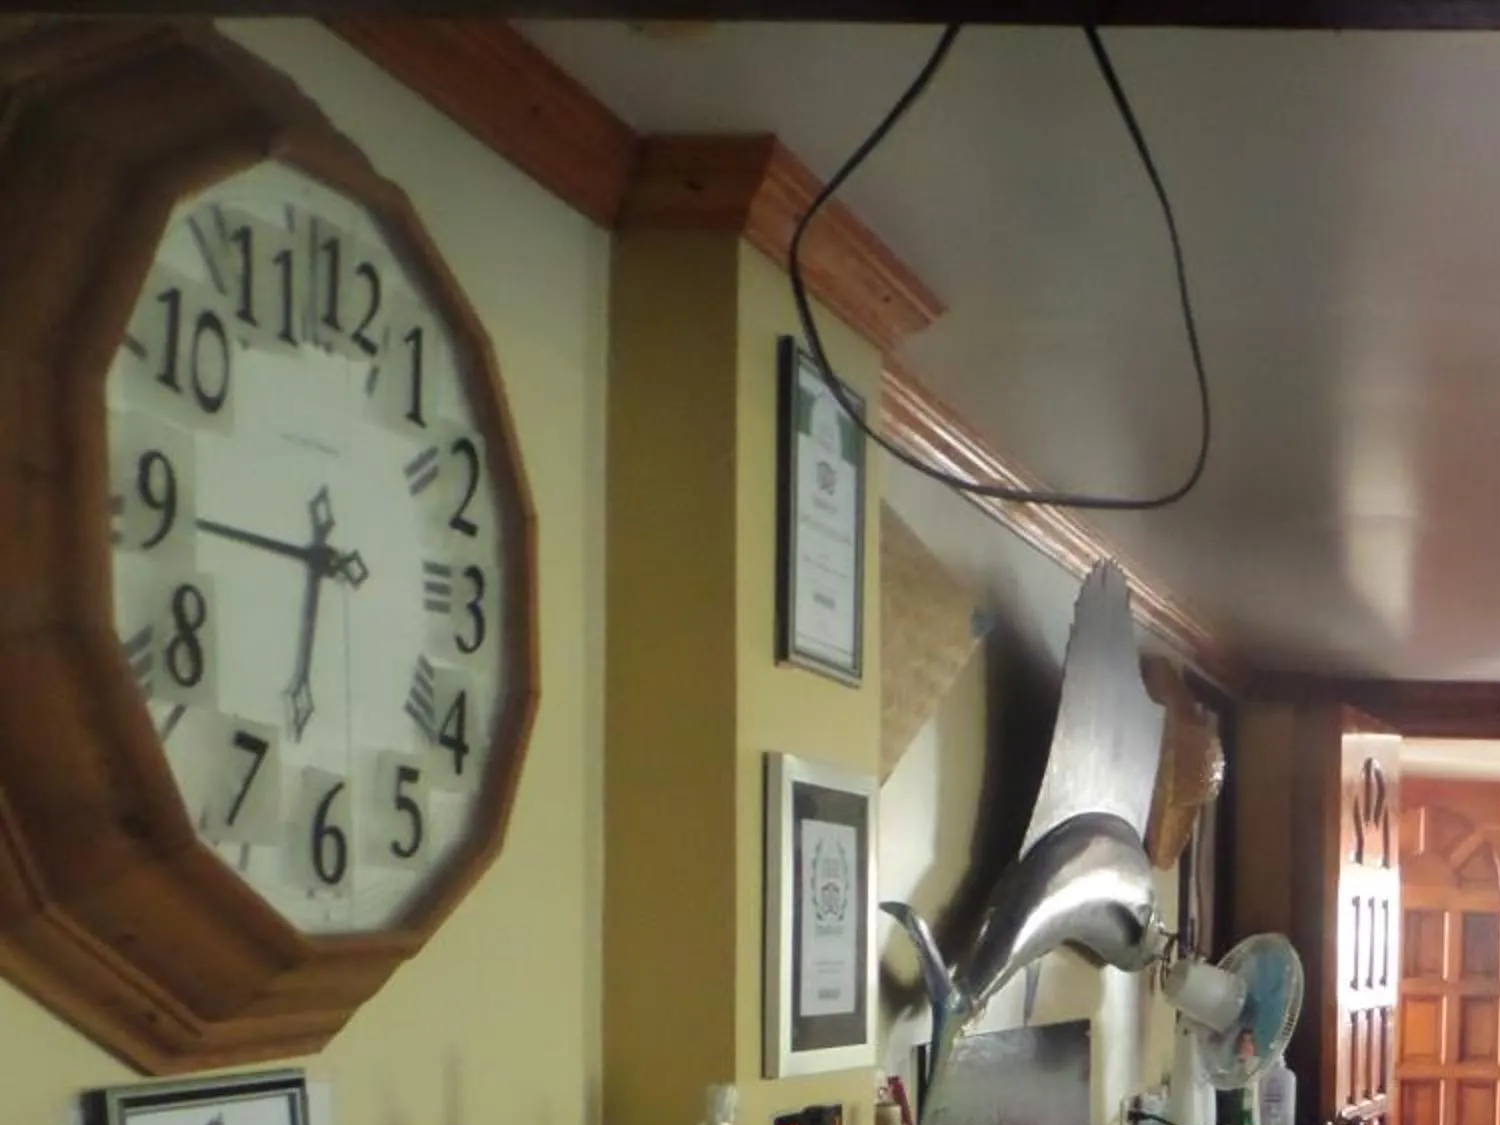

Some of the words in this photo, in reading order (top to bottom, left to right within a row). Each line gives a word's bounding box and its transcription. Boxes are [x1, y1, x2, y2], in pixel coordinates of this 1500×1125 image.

[231, 225, 298, 348] 11
[320, 236, 379, 356] 12
[157, 287, 230, 414] 10
[404, 326, 427, 429] 1
[138, 449, 177, 548] 9
[449, 437, 480, 538] 2
[166, 584, 206, 688] 8
[455, 564, 486, 655] 3
[233, 730, 269, 826] 7
[438, 690, 470, 776] 4
[310, 781, 347, 885] 6
[391, 765, 423, 860] 5
